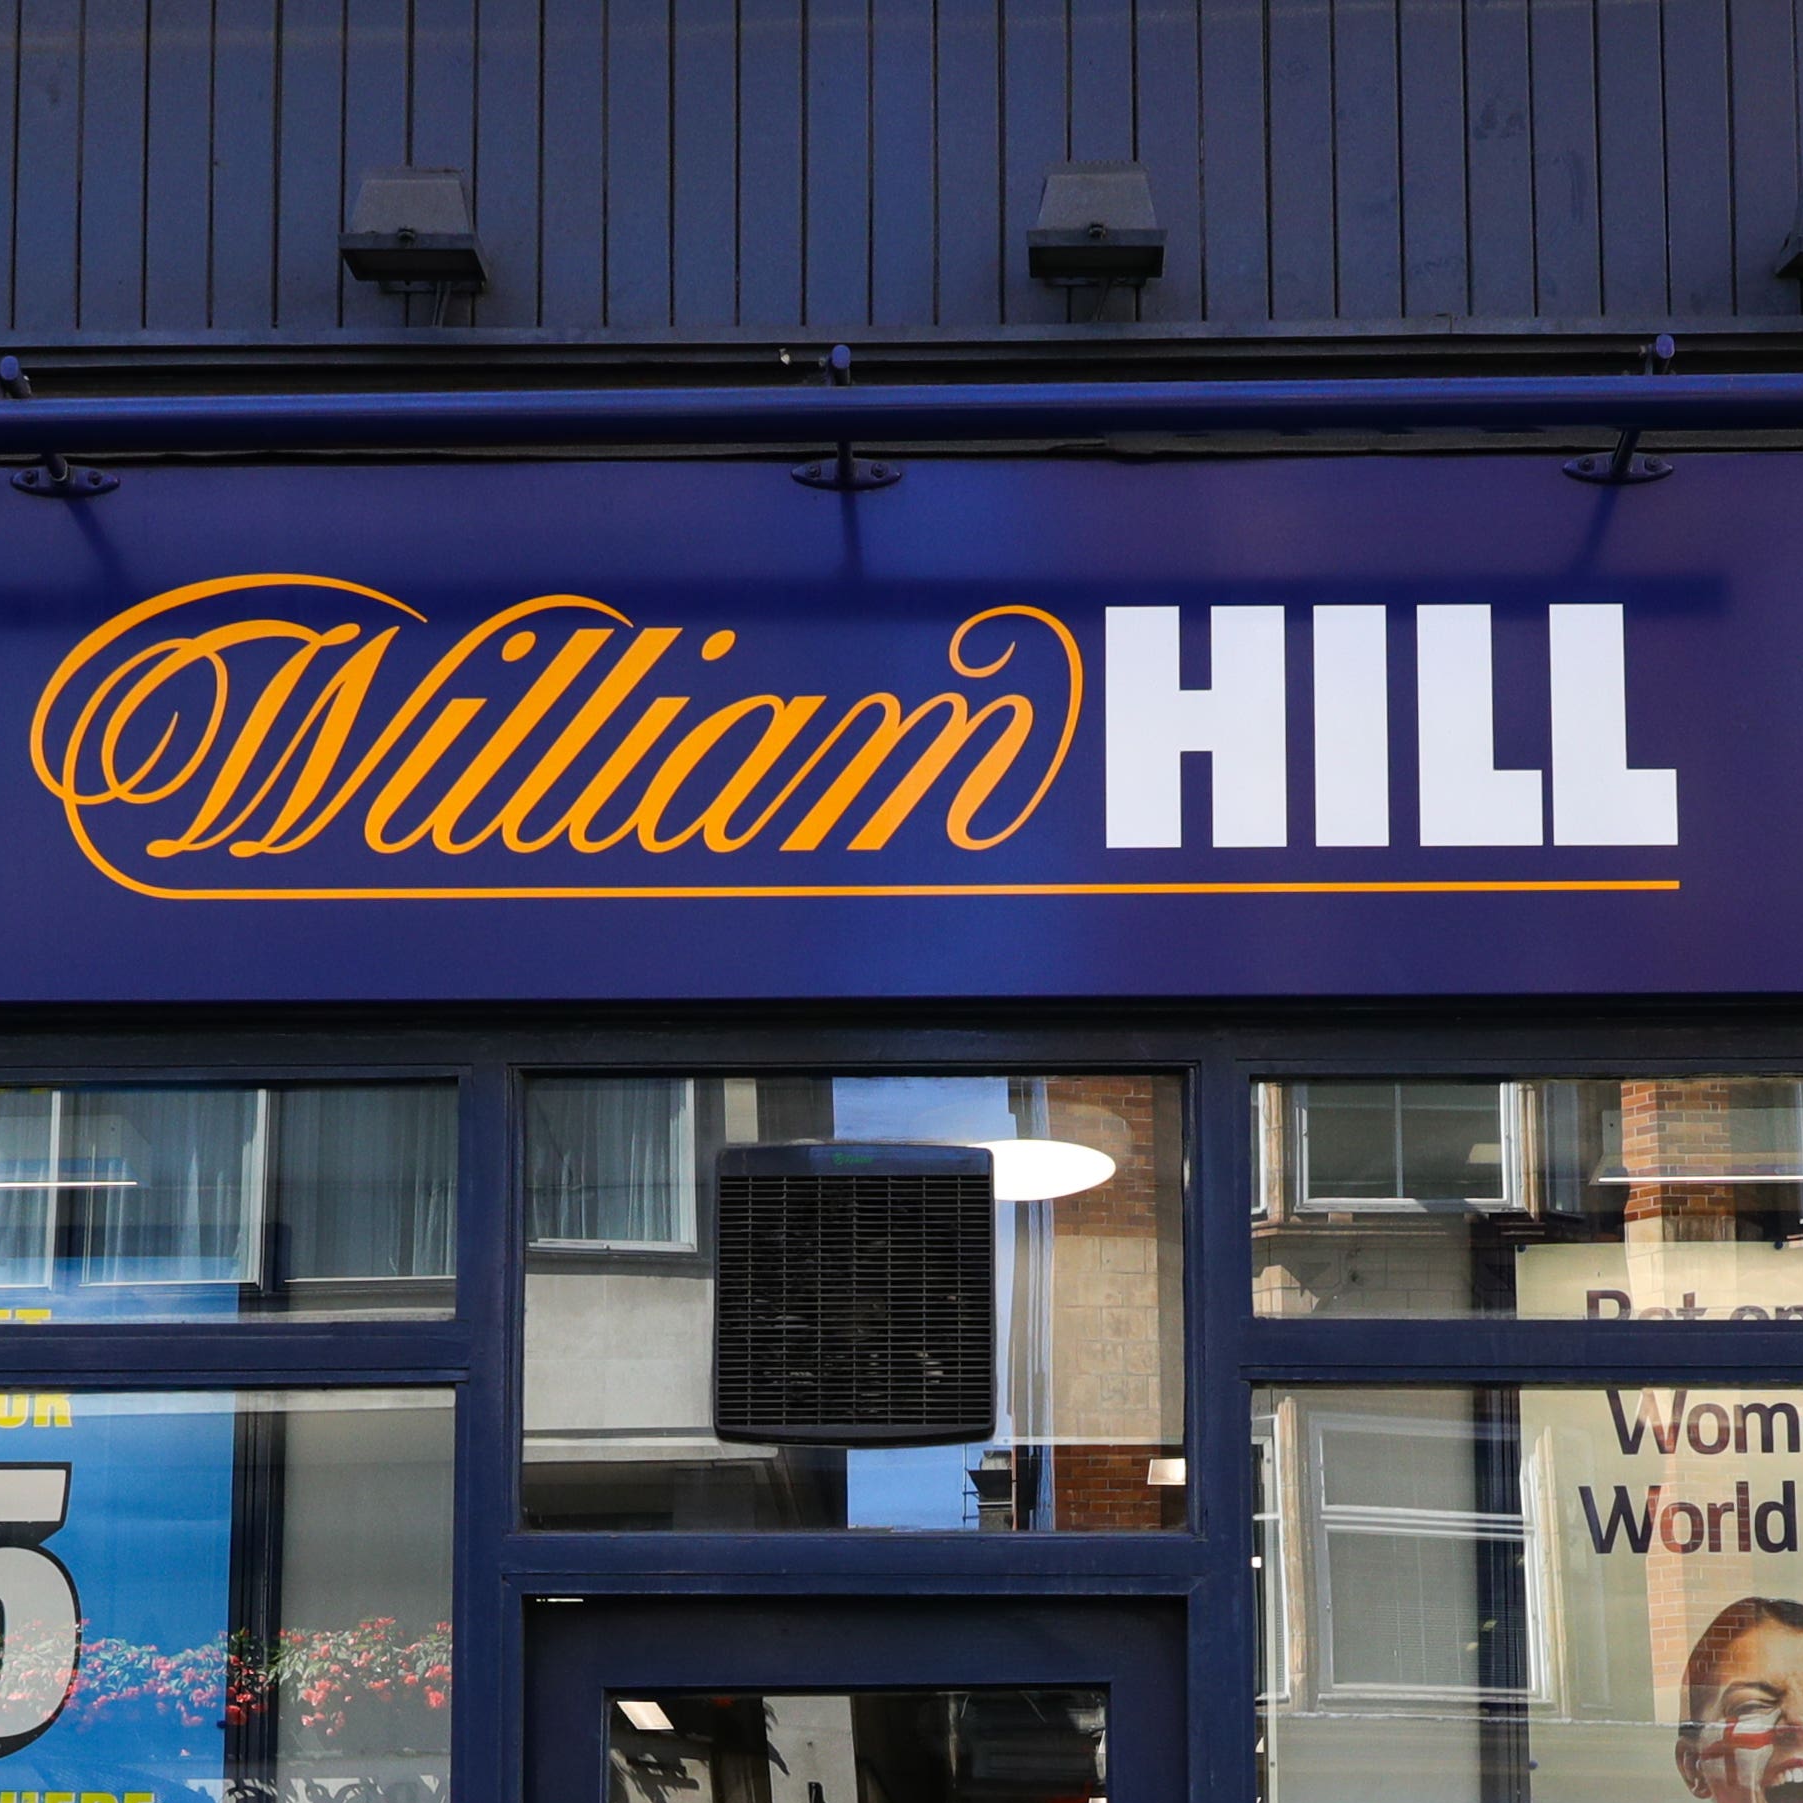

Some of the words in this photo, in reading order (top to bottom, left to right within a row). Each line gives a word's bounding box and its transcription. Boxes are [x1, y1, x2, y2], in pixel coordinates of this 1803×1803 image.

[31, 572, 1085, 897] William
[1105, 602, 1679, 849] HILL
[1578, 1481, 1796, 1555] World
